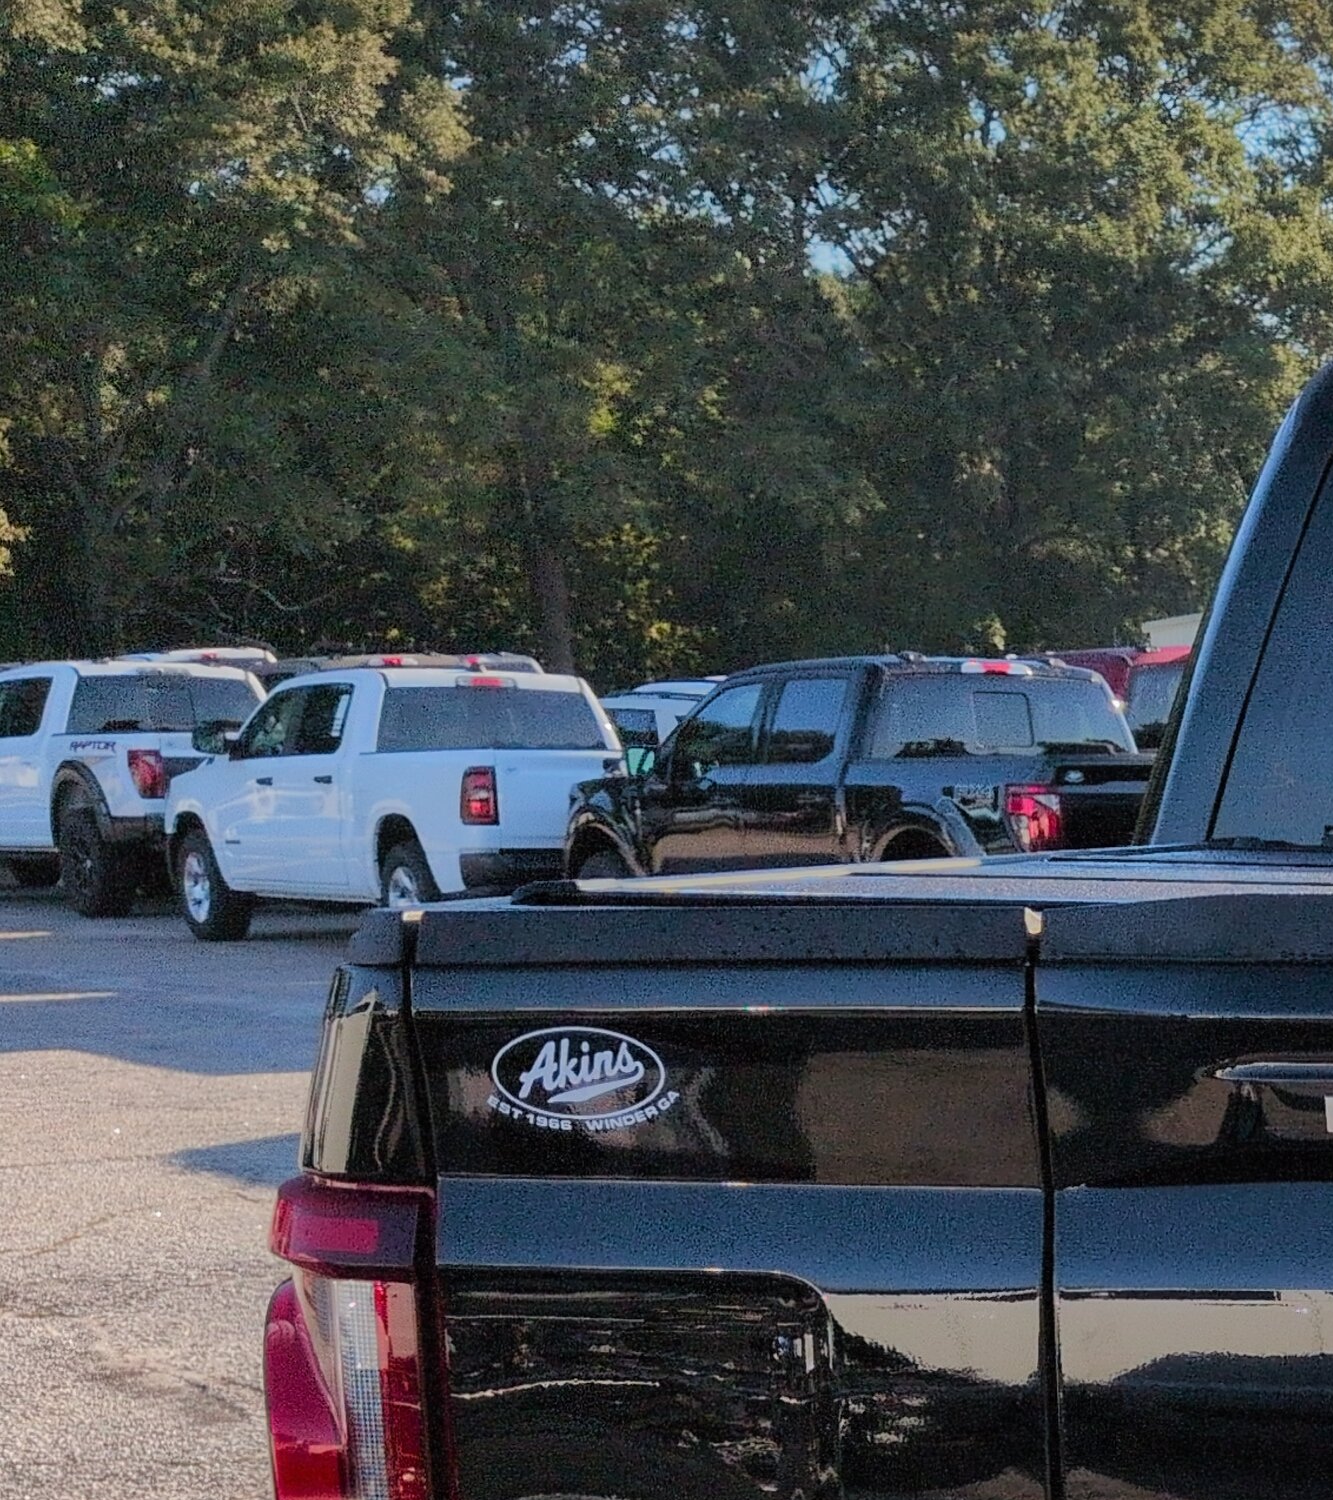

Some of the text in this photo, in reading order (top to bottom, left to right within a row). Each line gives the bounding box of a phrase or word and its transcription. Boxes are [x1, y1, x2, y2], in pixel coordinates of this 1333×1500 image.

[519, 1038, 645, 1103] Akins
[487, 1090, 680, 1131] EST 1966 WINDER GA
